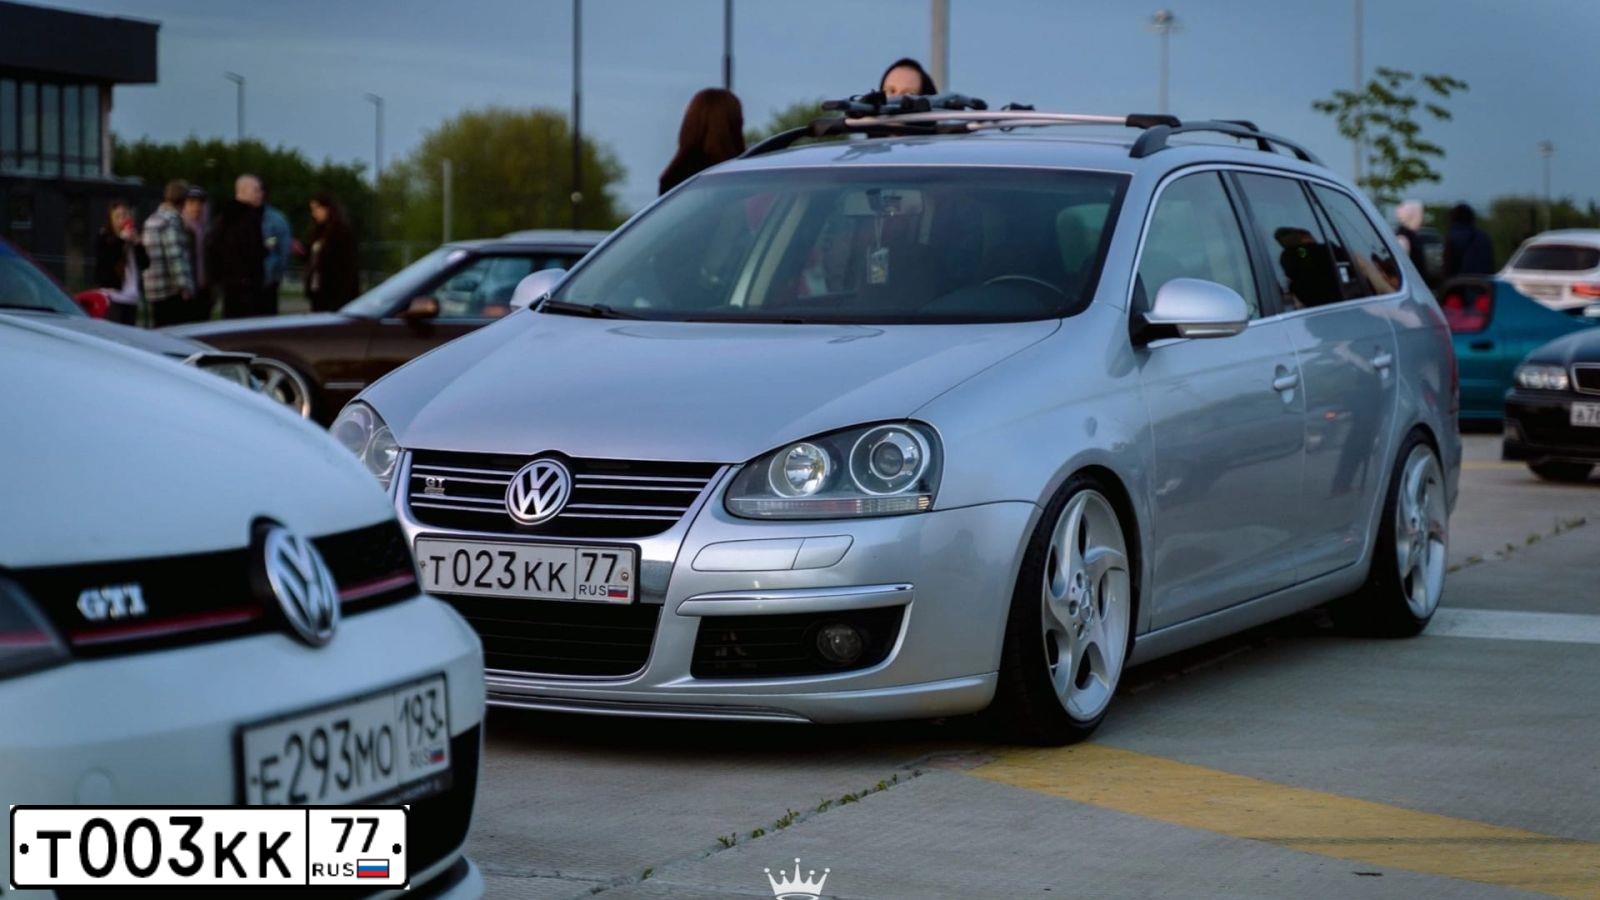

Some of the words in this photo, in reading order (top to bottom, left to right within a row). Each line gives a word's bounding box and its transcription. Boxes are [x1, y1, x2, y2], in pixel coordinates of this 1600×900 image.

[425, 476, 446, 488] GT
[509, 461, 568, 521] VW
[430, 549, 567, 592] T023KK
[582, 552, 618, 583] 77
[579, 584, 607, 596] RUS
[77, 583, 147, 620] GTI
[400, 688, 443, 745] 193
